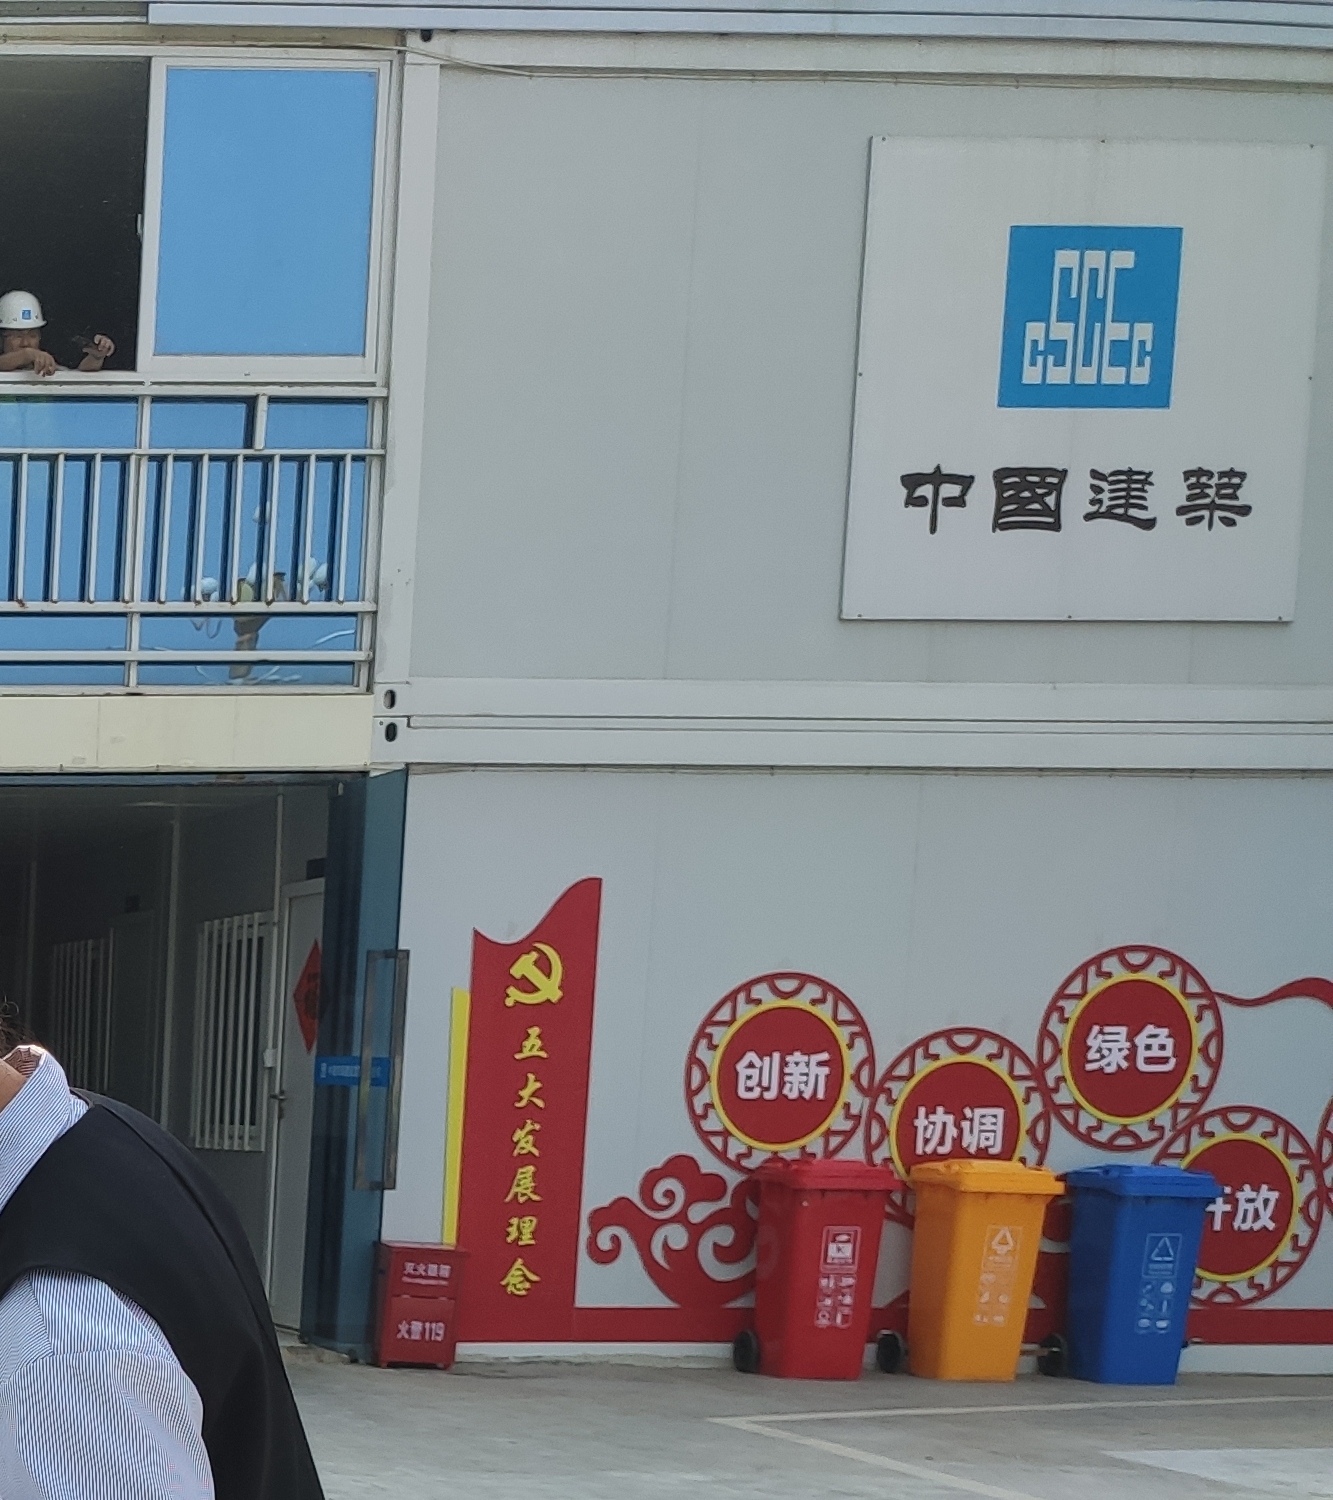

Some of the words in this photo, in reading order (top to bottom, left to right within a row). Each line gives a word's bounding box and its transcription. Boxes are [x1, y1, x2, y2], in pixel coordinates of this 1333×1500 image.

[1084, 1024, 1176, 1073] 绿色
[734, 1050, 831, 1101] 创新
[913, 1106, 1005, 1156] 协调
[500, 1026, 548, 1297] 五大发展理念
